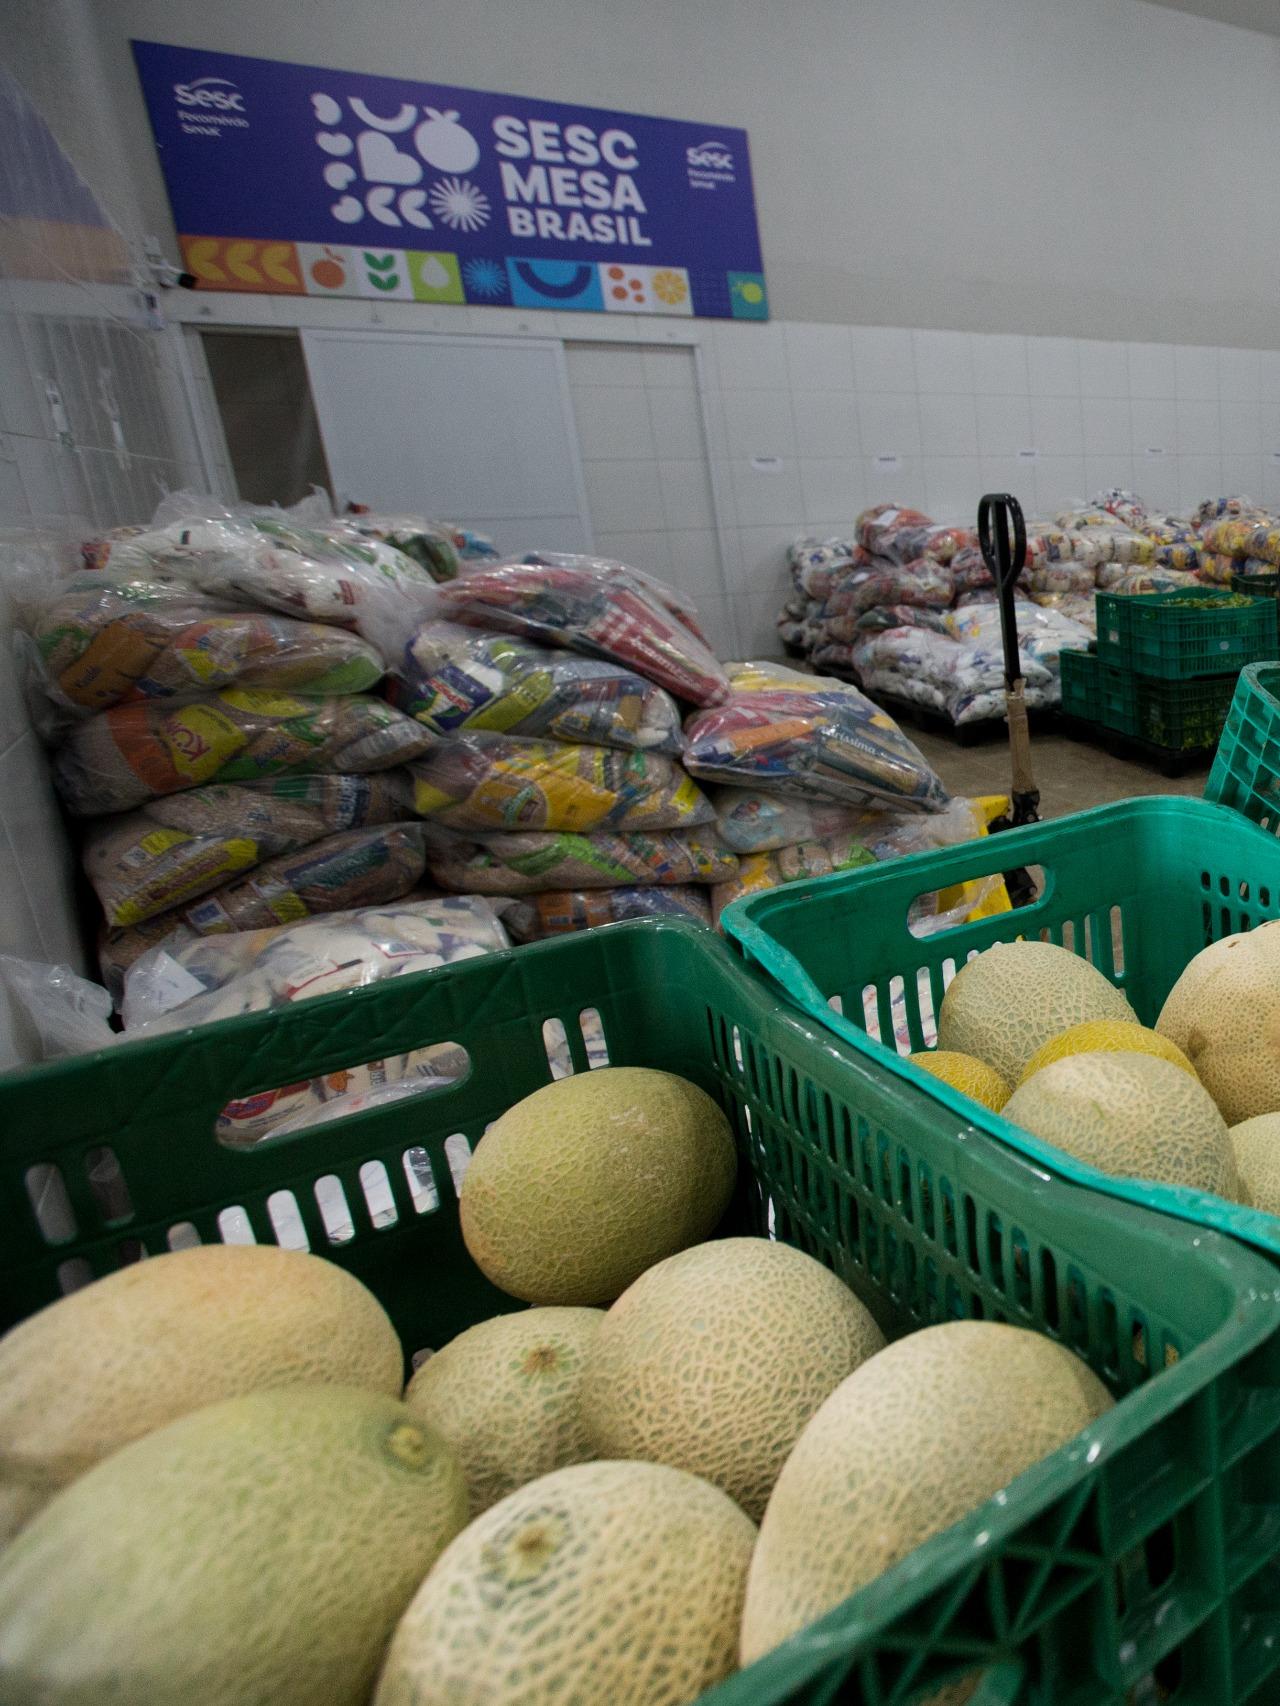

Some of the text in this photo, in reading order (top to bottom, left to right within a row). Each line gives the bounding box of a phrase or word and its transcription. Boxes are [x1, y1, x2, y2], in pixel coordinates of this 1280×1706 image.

[174, 78, 247, 112] Sesc
[492, 115, 640, 171] SESC
[500, 161, 648, 214] MESA
[507, 206, 652, 247] BRASIL
